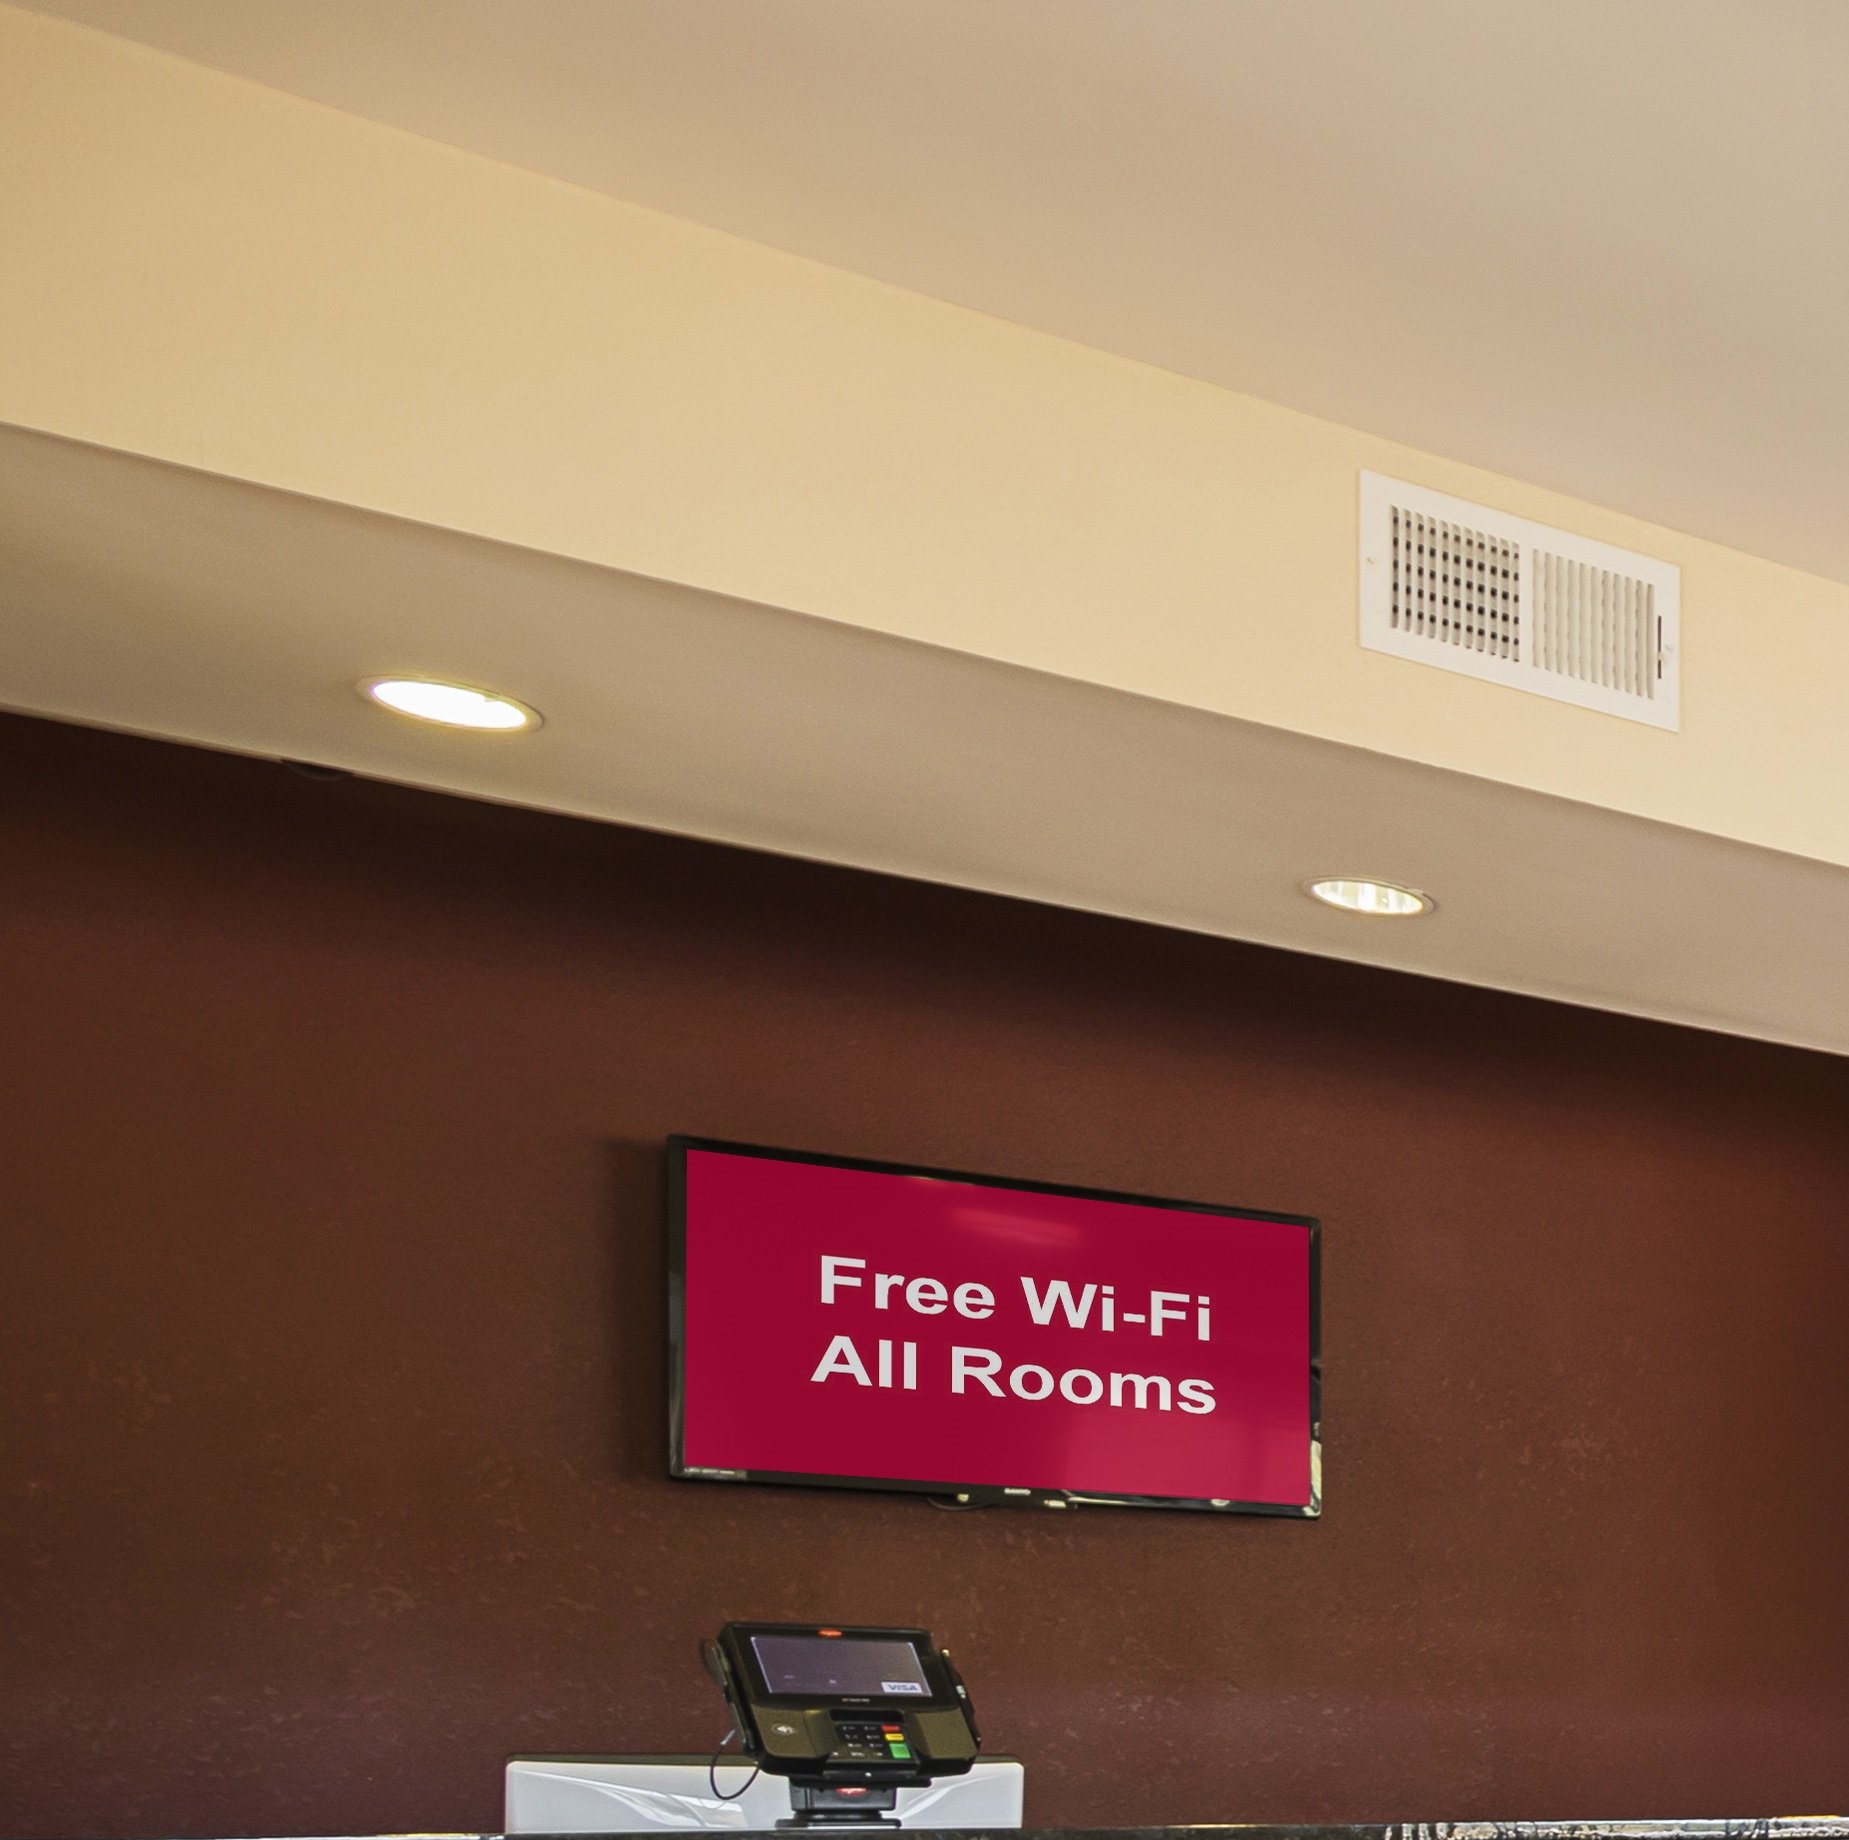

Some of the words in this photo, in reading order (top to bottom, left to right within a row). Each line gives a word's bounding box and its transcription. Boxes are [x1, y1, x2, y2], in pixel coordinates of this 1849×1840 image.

[820, 1254, 997, 1320] Free
[1020, 1276, 1211, 1342] Wi-Fi
[810, 1335, 917, 1390] All
[951, 1345, 1218, 1416] Rooms
